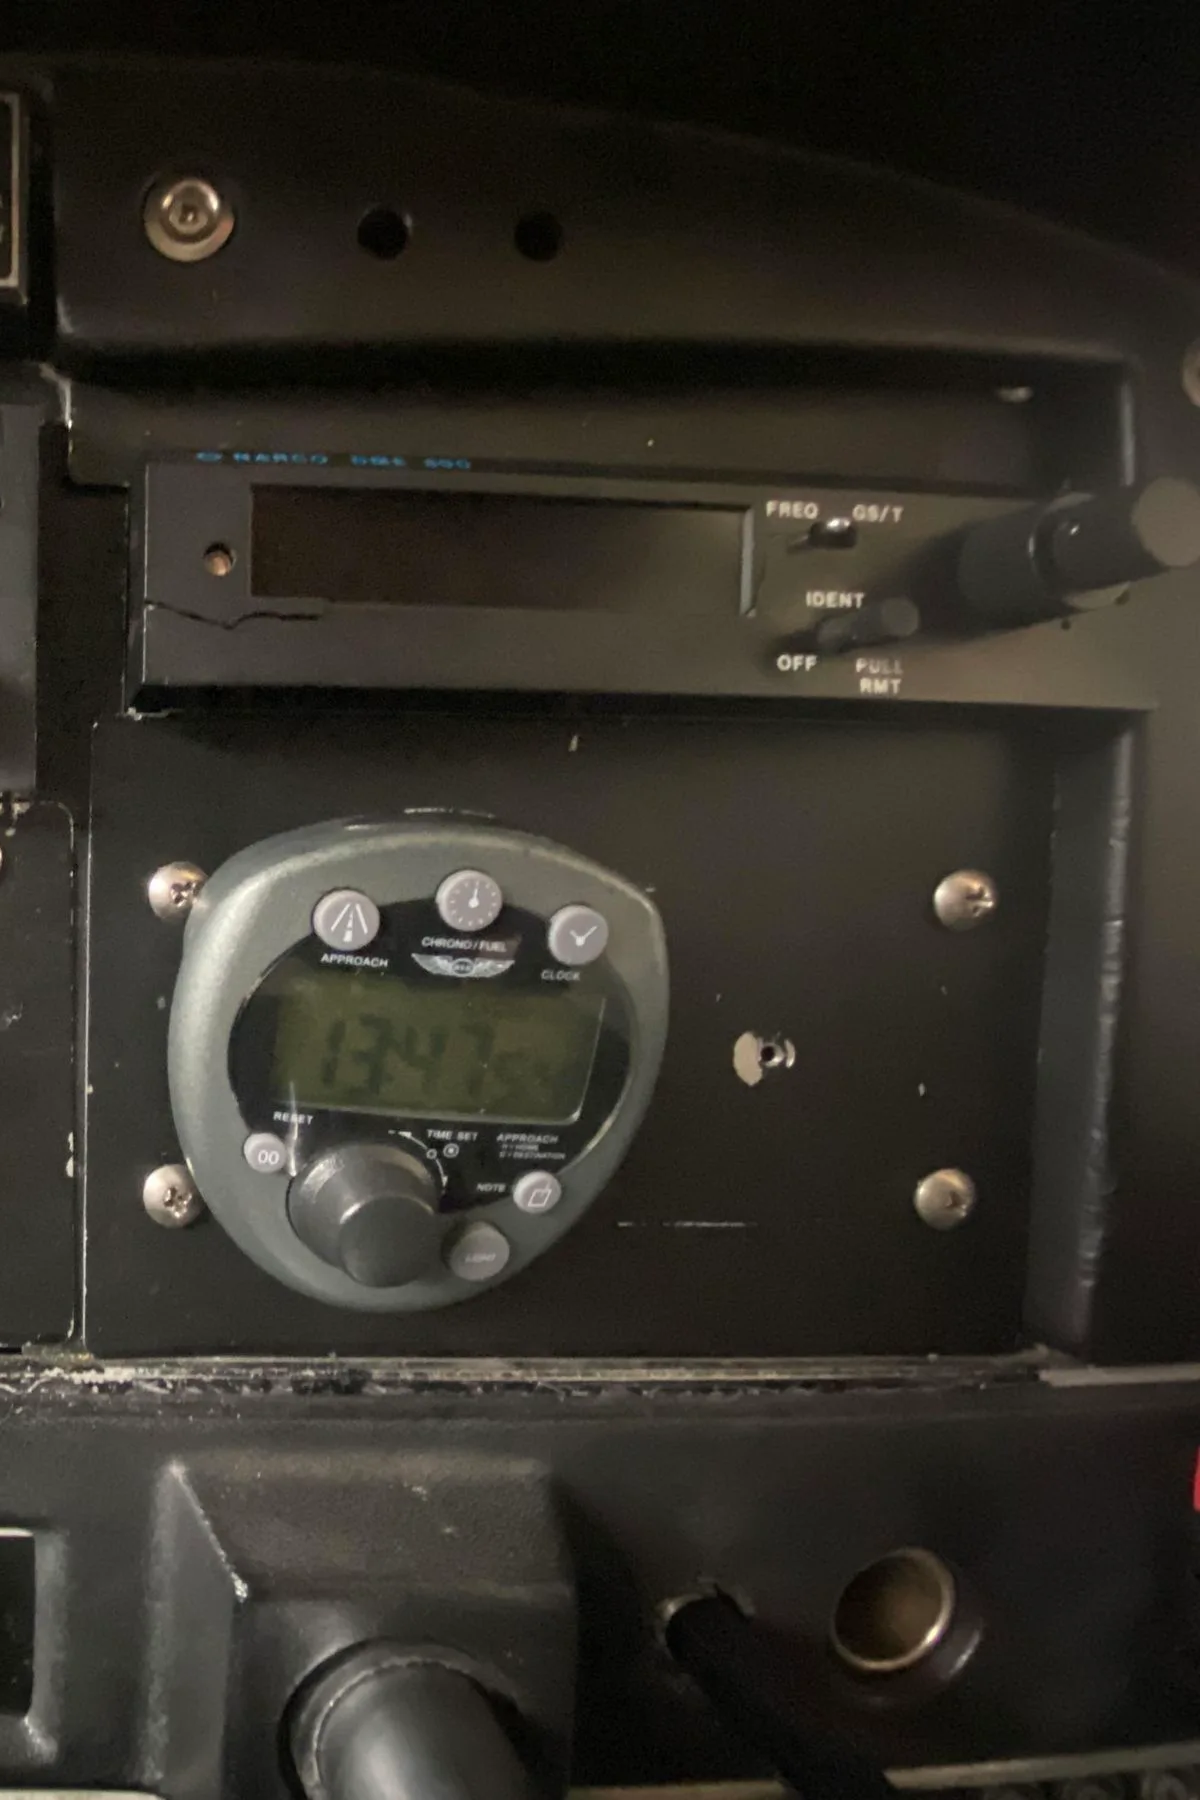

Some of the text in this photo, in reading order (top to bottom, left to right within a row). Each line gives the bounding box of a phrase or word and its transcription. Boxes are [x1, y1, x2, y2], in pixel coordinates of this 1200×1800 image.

[765, 500, 819, 519] FREQ
[852, 504, 904, 523] GS/T
[806, 591, 865, 609] IDENT
[776, 654, 817, 672] OFF
[855, 658, 903, 675] PULL
[859, 678, 903, 695] RMT
[320, 952, 389, 968] APPROACH
[541, 969, 581, 982] CLOCK
[273, 1111, 314, 1125] RESET
[426, 1129, 479, 1141] TIME SET
[496, 1132, 559, 1144] APPROACH
[476, 1183, 506, 1193] NOTE
